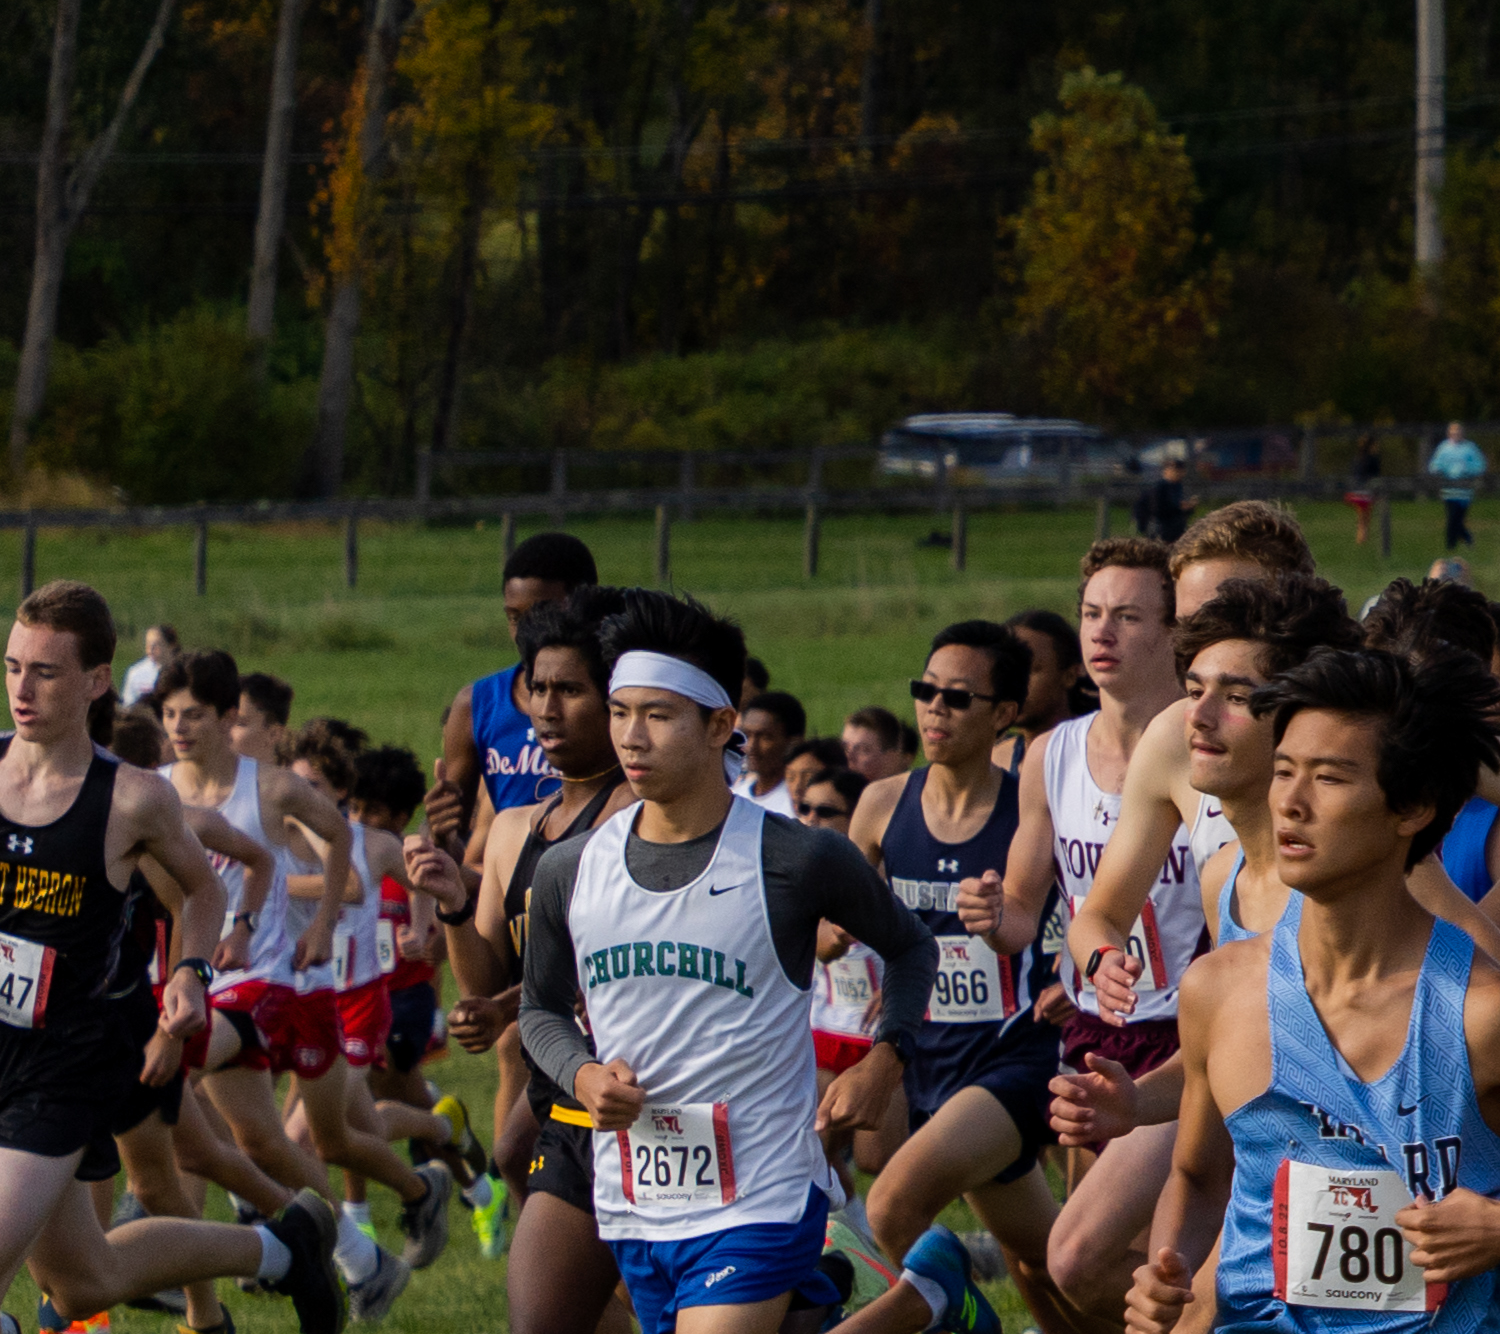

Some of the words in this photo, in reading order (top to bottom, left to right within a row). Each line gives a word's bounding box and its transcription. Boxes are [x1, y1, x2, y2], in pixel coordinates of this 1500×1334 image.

[1059, 836, 1189, 884] TOWN
[14, 864, 87, 917] HEBRON
[892, 876, 959, 913] USTA
[0, 971, 35, 1011] 47
[584, 940, 755, 1000] CHURCHILL
[934, 969, 989, 1006] 966
[635, 1145, 715, 1187] 2672
[1328, 1175, 1379, 1187] MARYLAND
[1277, 1202, 1289, 1257] 10.8.22
[1306, 1221, 1404, 1286] 780
[1324, 1289, 1383, 1303] saucony
